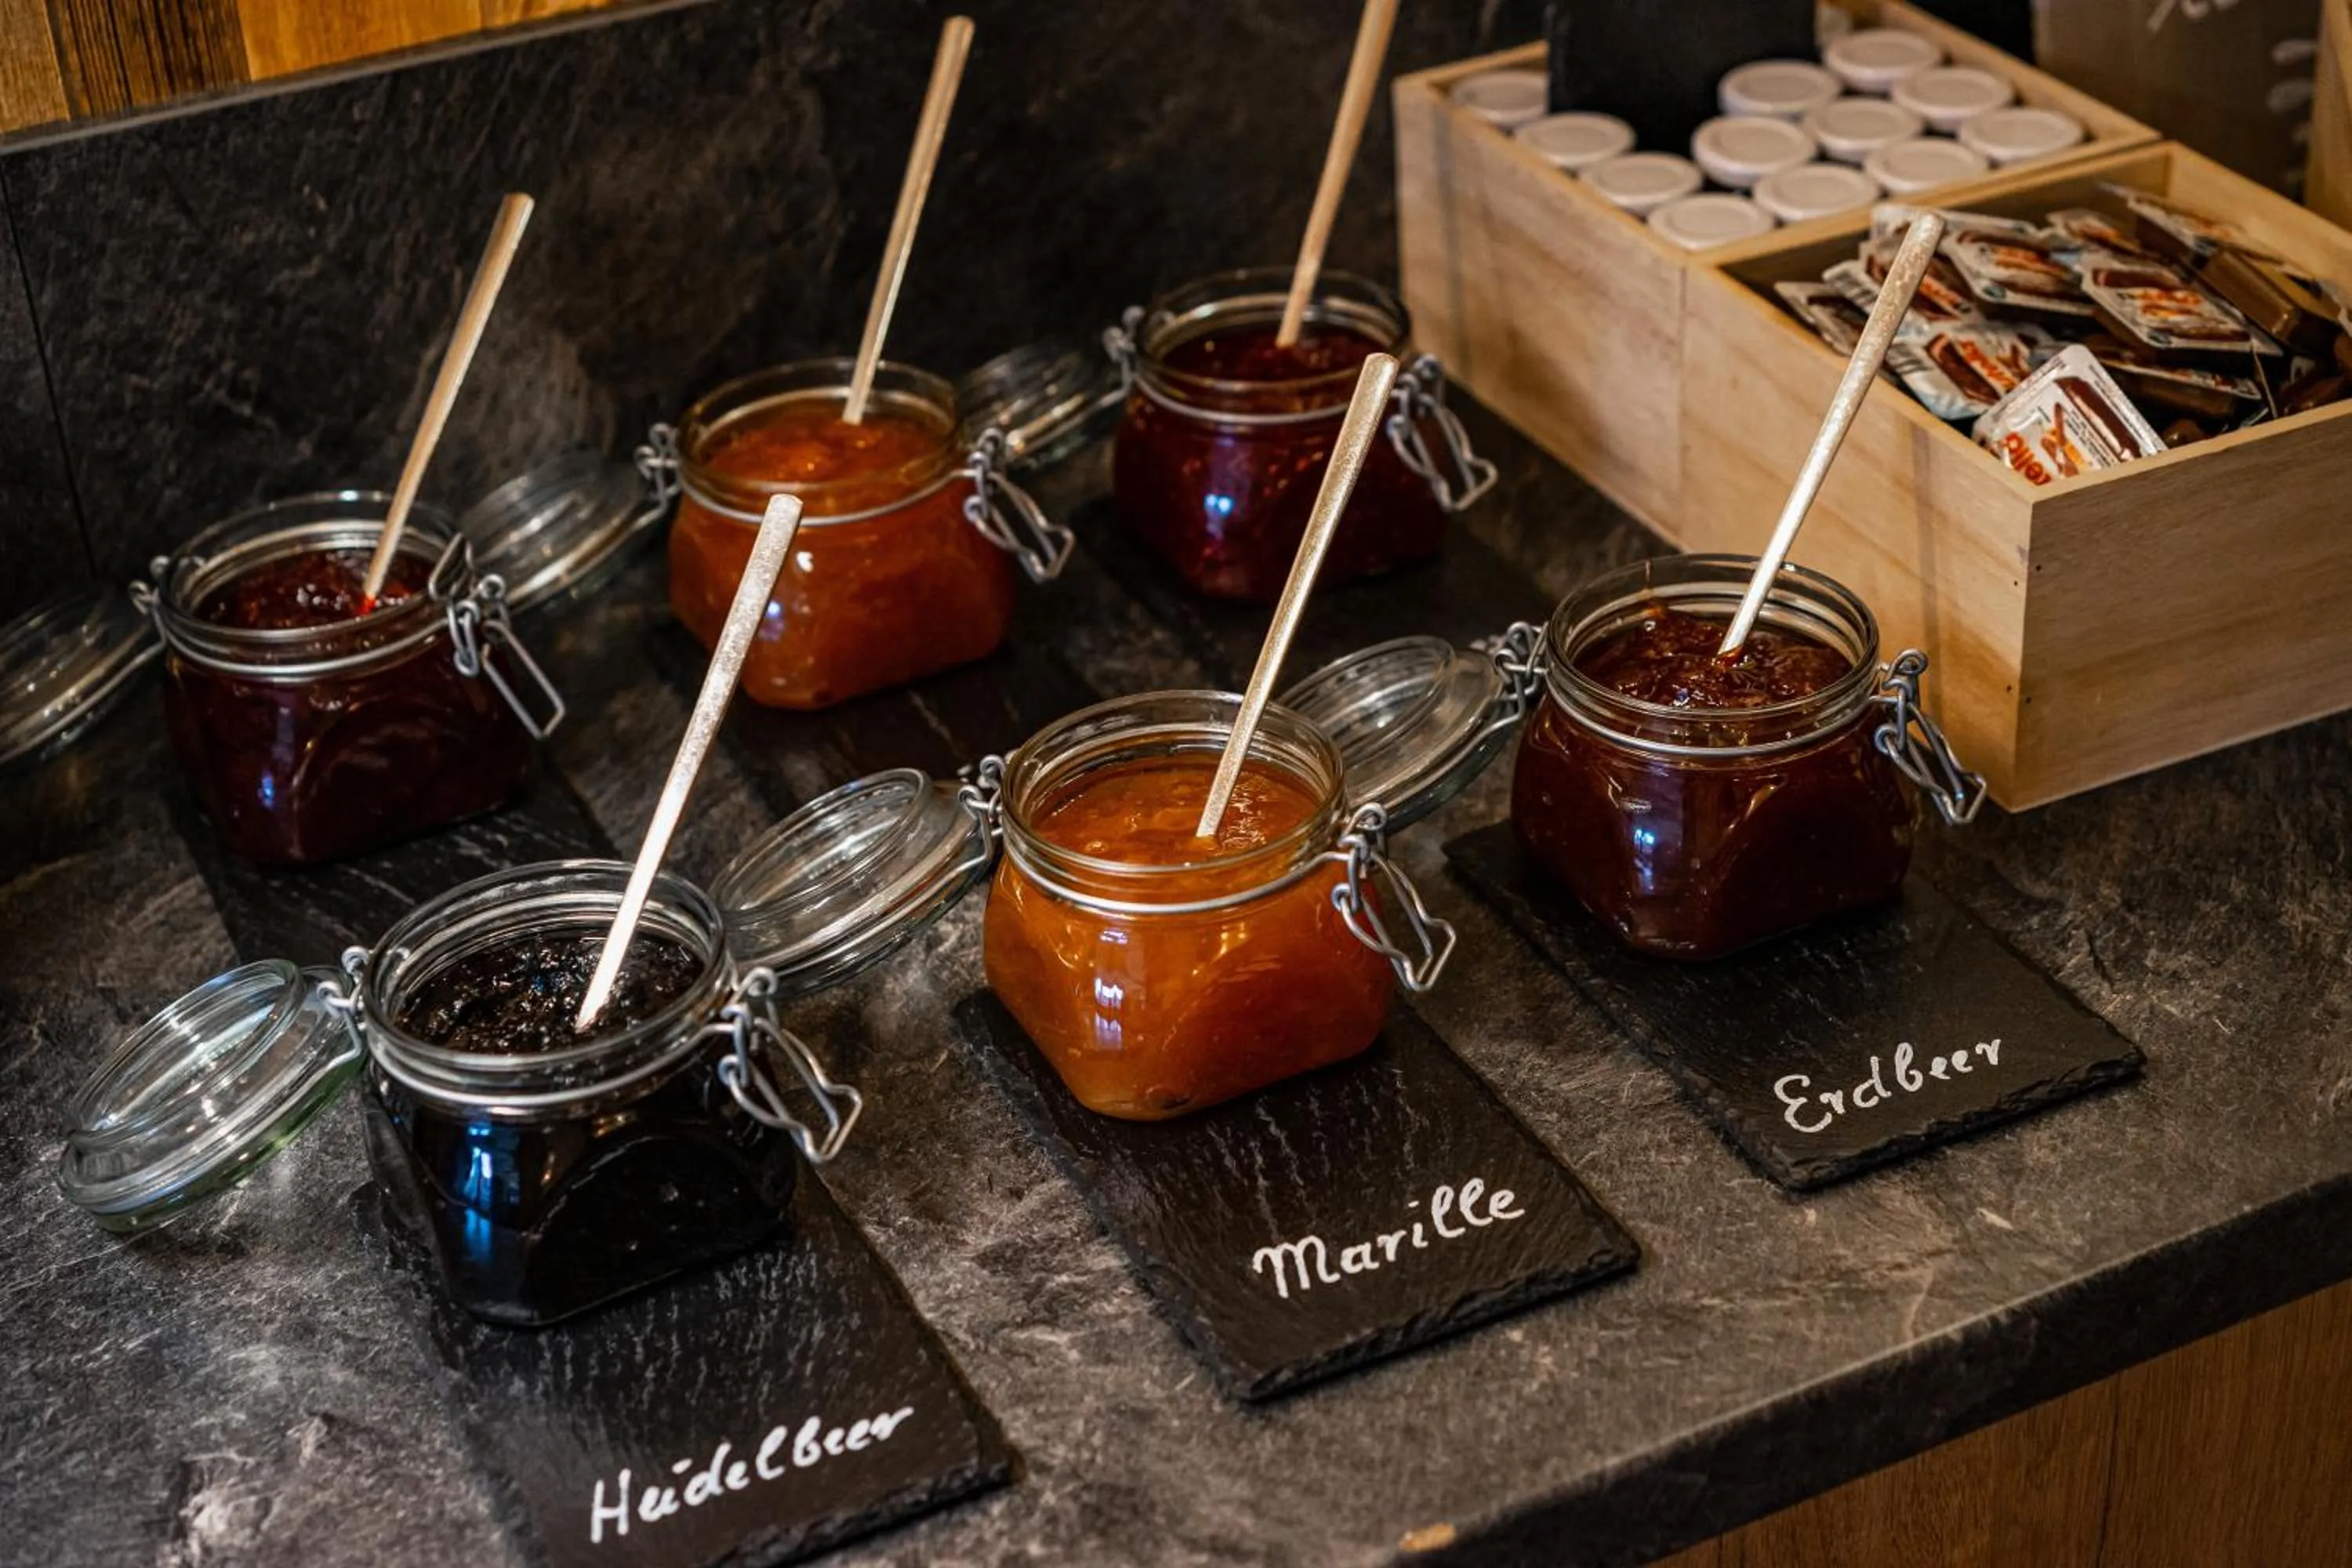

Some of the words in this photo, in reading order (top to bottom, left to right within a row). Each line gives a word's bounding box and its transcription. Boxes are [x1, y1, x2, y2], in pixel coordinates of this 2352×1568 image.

[1773, 1038, 2002, 1134] Erdbeer
[1251, 1177, 1526, 1299] Marille
[590, 1406, 914, 1544] Heidelbeer
